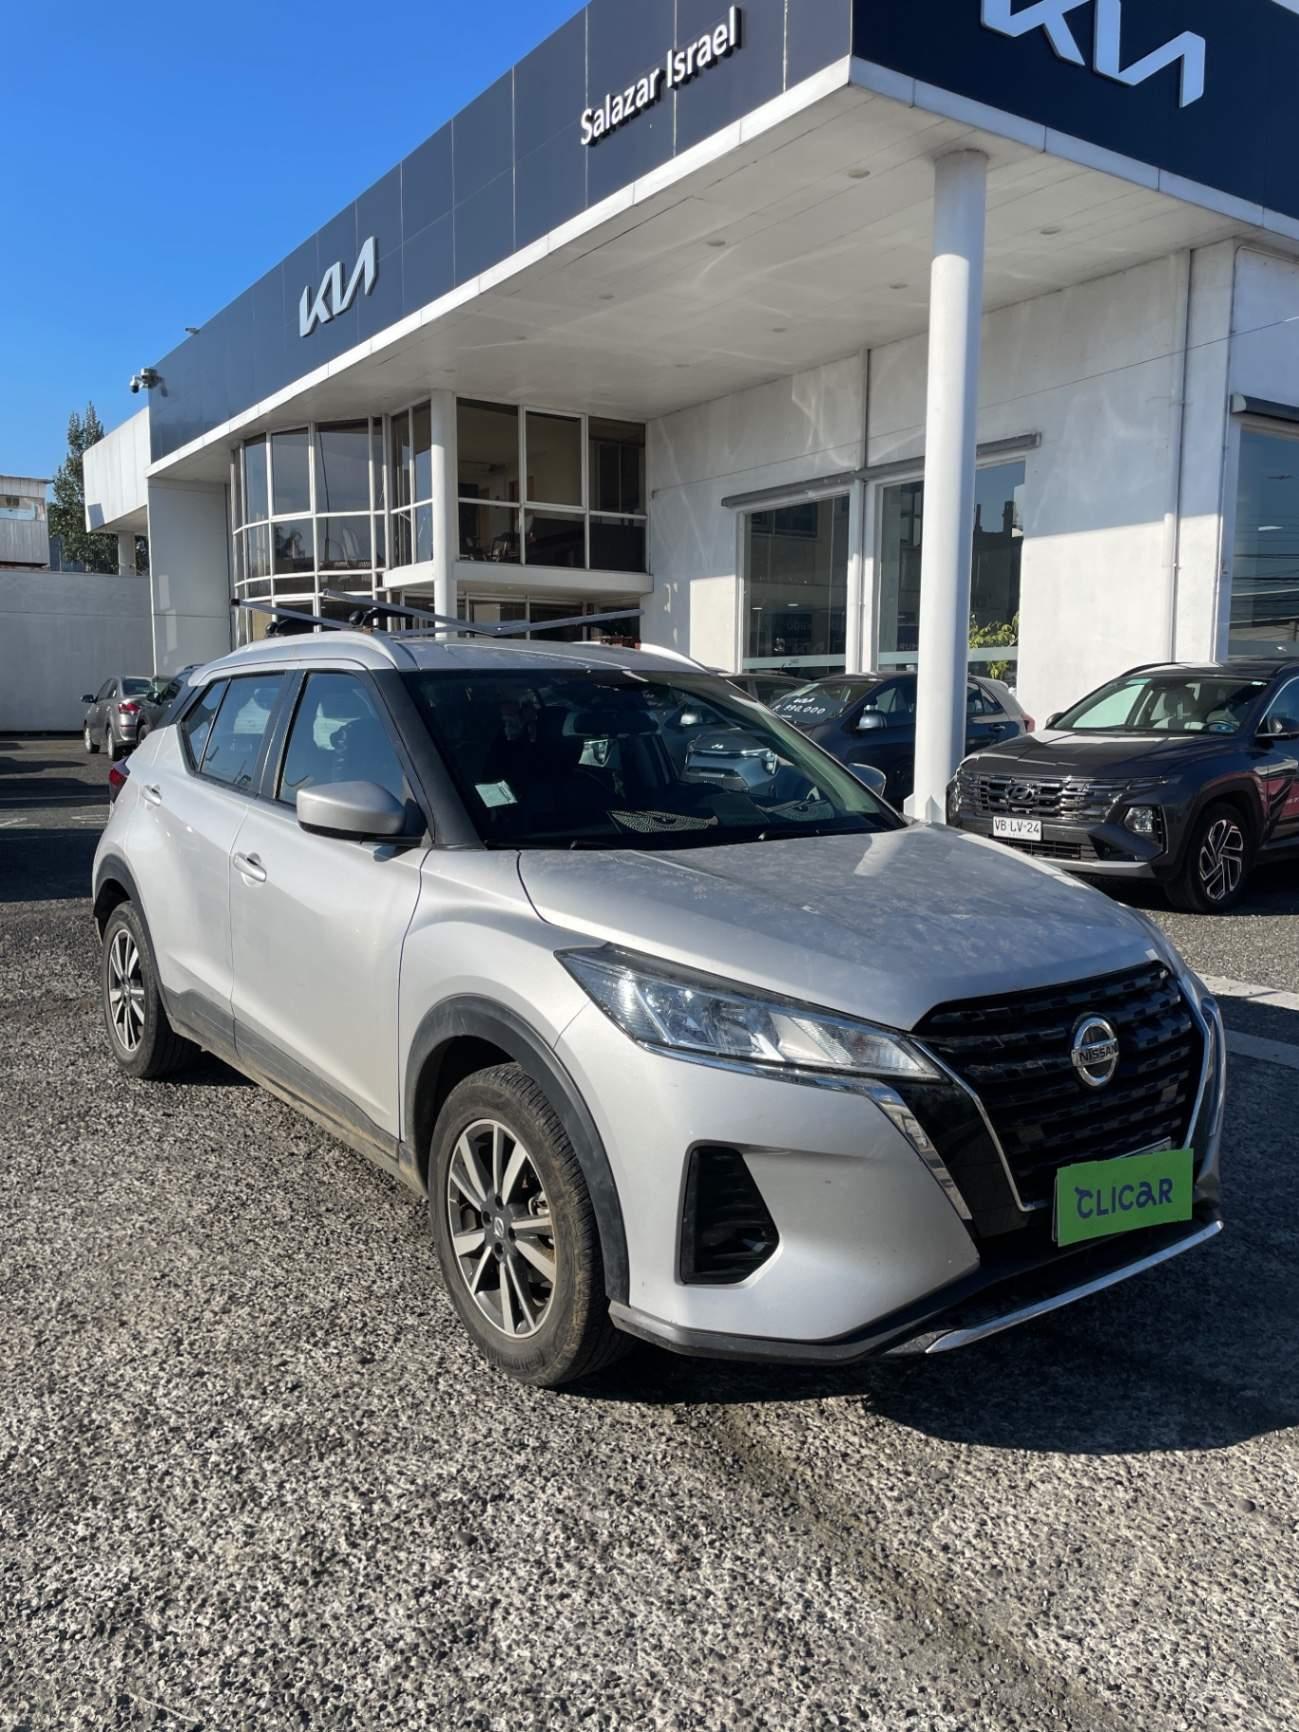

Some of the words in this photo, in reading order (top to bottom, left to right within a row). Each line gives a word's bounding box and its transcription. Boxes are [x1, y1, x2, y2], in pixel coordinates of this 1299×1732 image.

[580, 67, 660, 145] Salazar
[667, 5, 736, 88] Israel
[299, 235, 376, 337] KIA
[1078, 1042, 1119, 1061] NISSAN
